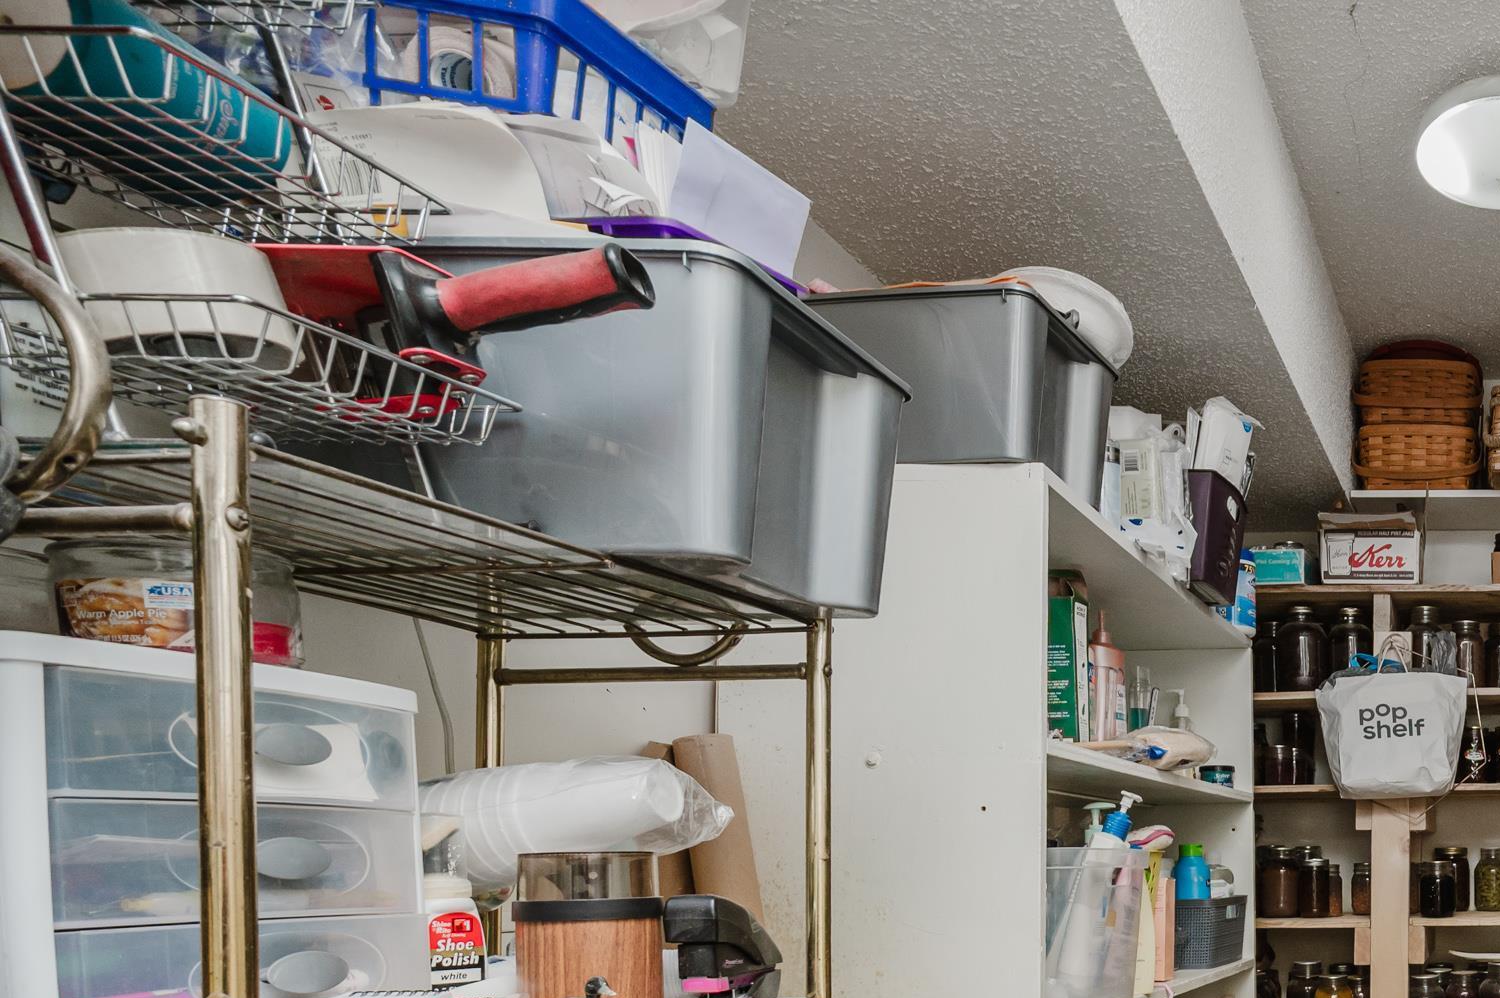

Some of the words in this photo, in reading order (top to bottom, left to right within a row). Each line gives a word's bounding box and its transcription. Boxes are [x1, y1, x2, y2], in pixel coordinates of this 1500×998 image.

[1348, 543, 1406, 568] Kerr
[160, 585, 192, 597] USA
[78, 608, 107, 620] Warm
[109, 608, 145, 620] Apple
[147, 608, 168, 619] Pie
[1359, 703, 1408, 726] pop
[1363, 718, 1425, 740] shelf
[436, 938, 474, 952] Shoe
[431, 951, 480, 968] Polish
[441, 972, 468, 981] white
